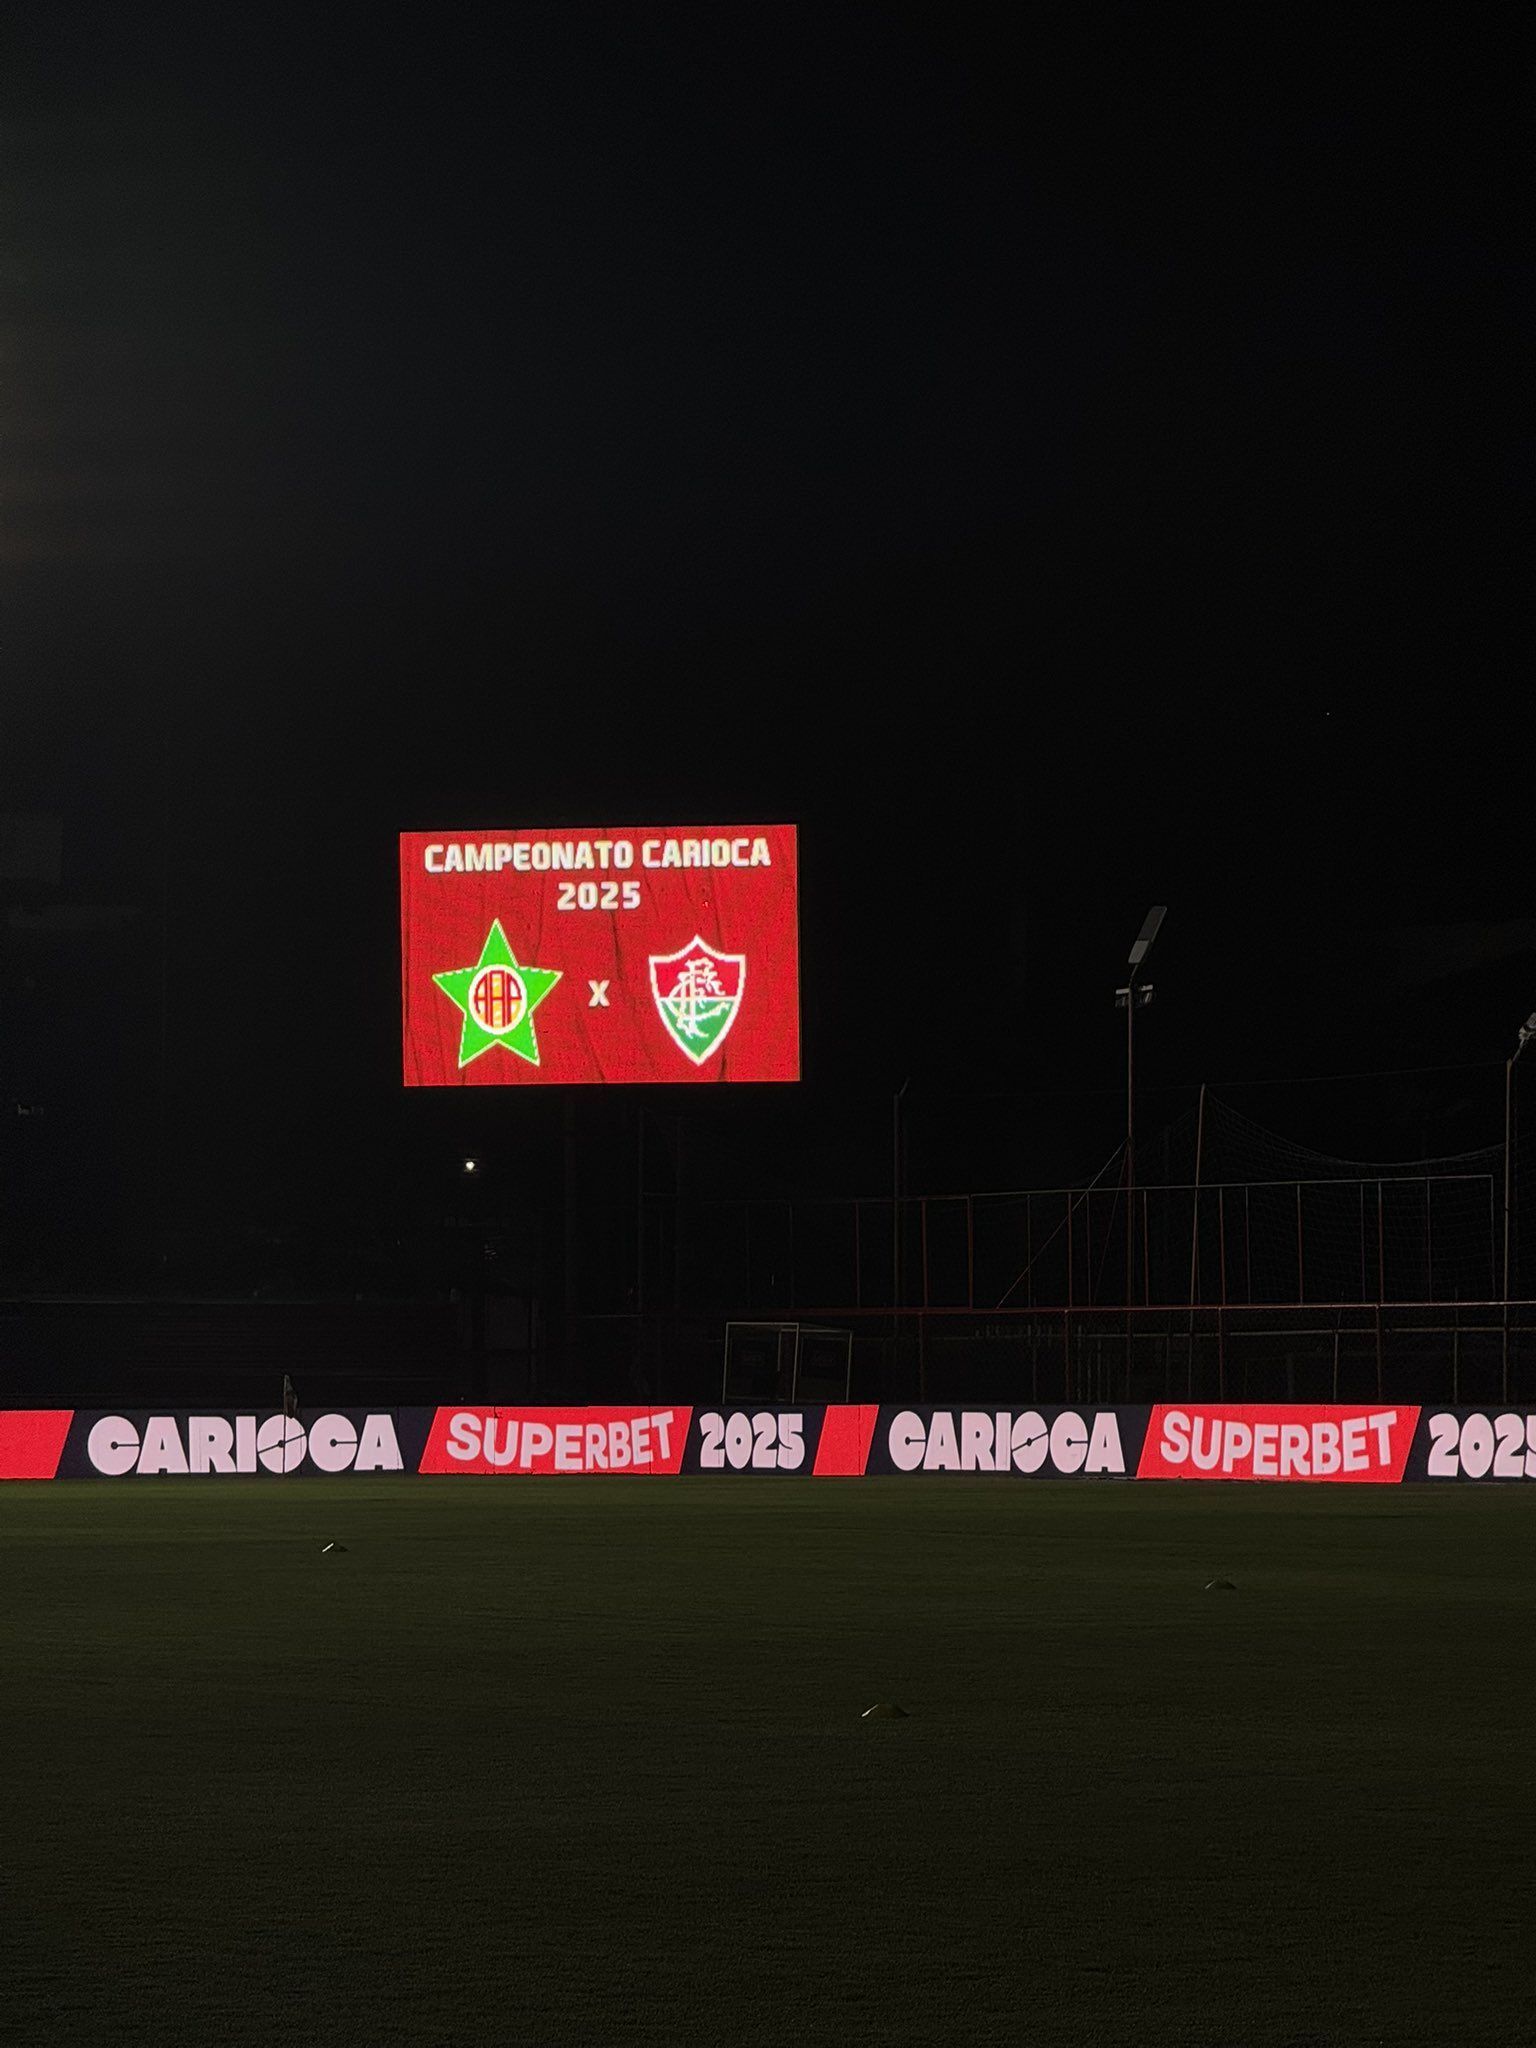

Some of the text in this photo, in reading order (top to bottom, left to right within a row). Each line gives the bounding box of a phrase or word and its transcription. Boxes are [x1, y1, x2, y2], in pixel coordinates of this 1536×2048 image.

[424, 838, 772, 873] CAMPEONATO CARIOCA
[557, 881, 642, 911] 2025
[87, 1410, 805, 1476] CARIOCA SUPERBET 2025
[888, 1411, 1126, 1474] CARIOCA
[1160, 1410, 1398, 1476] SUPERBET
